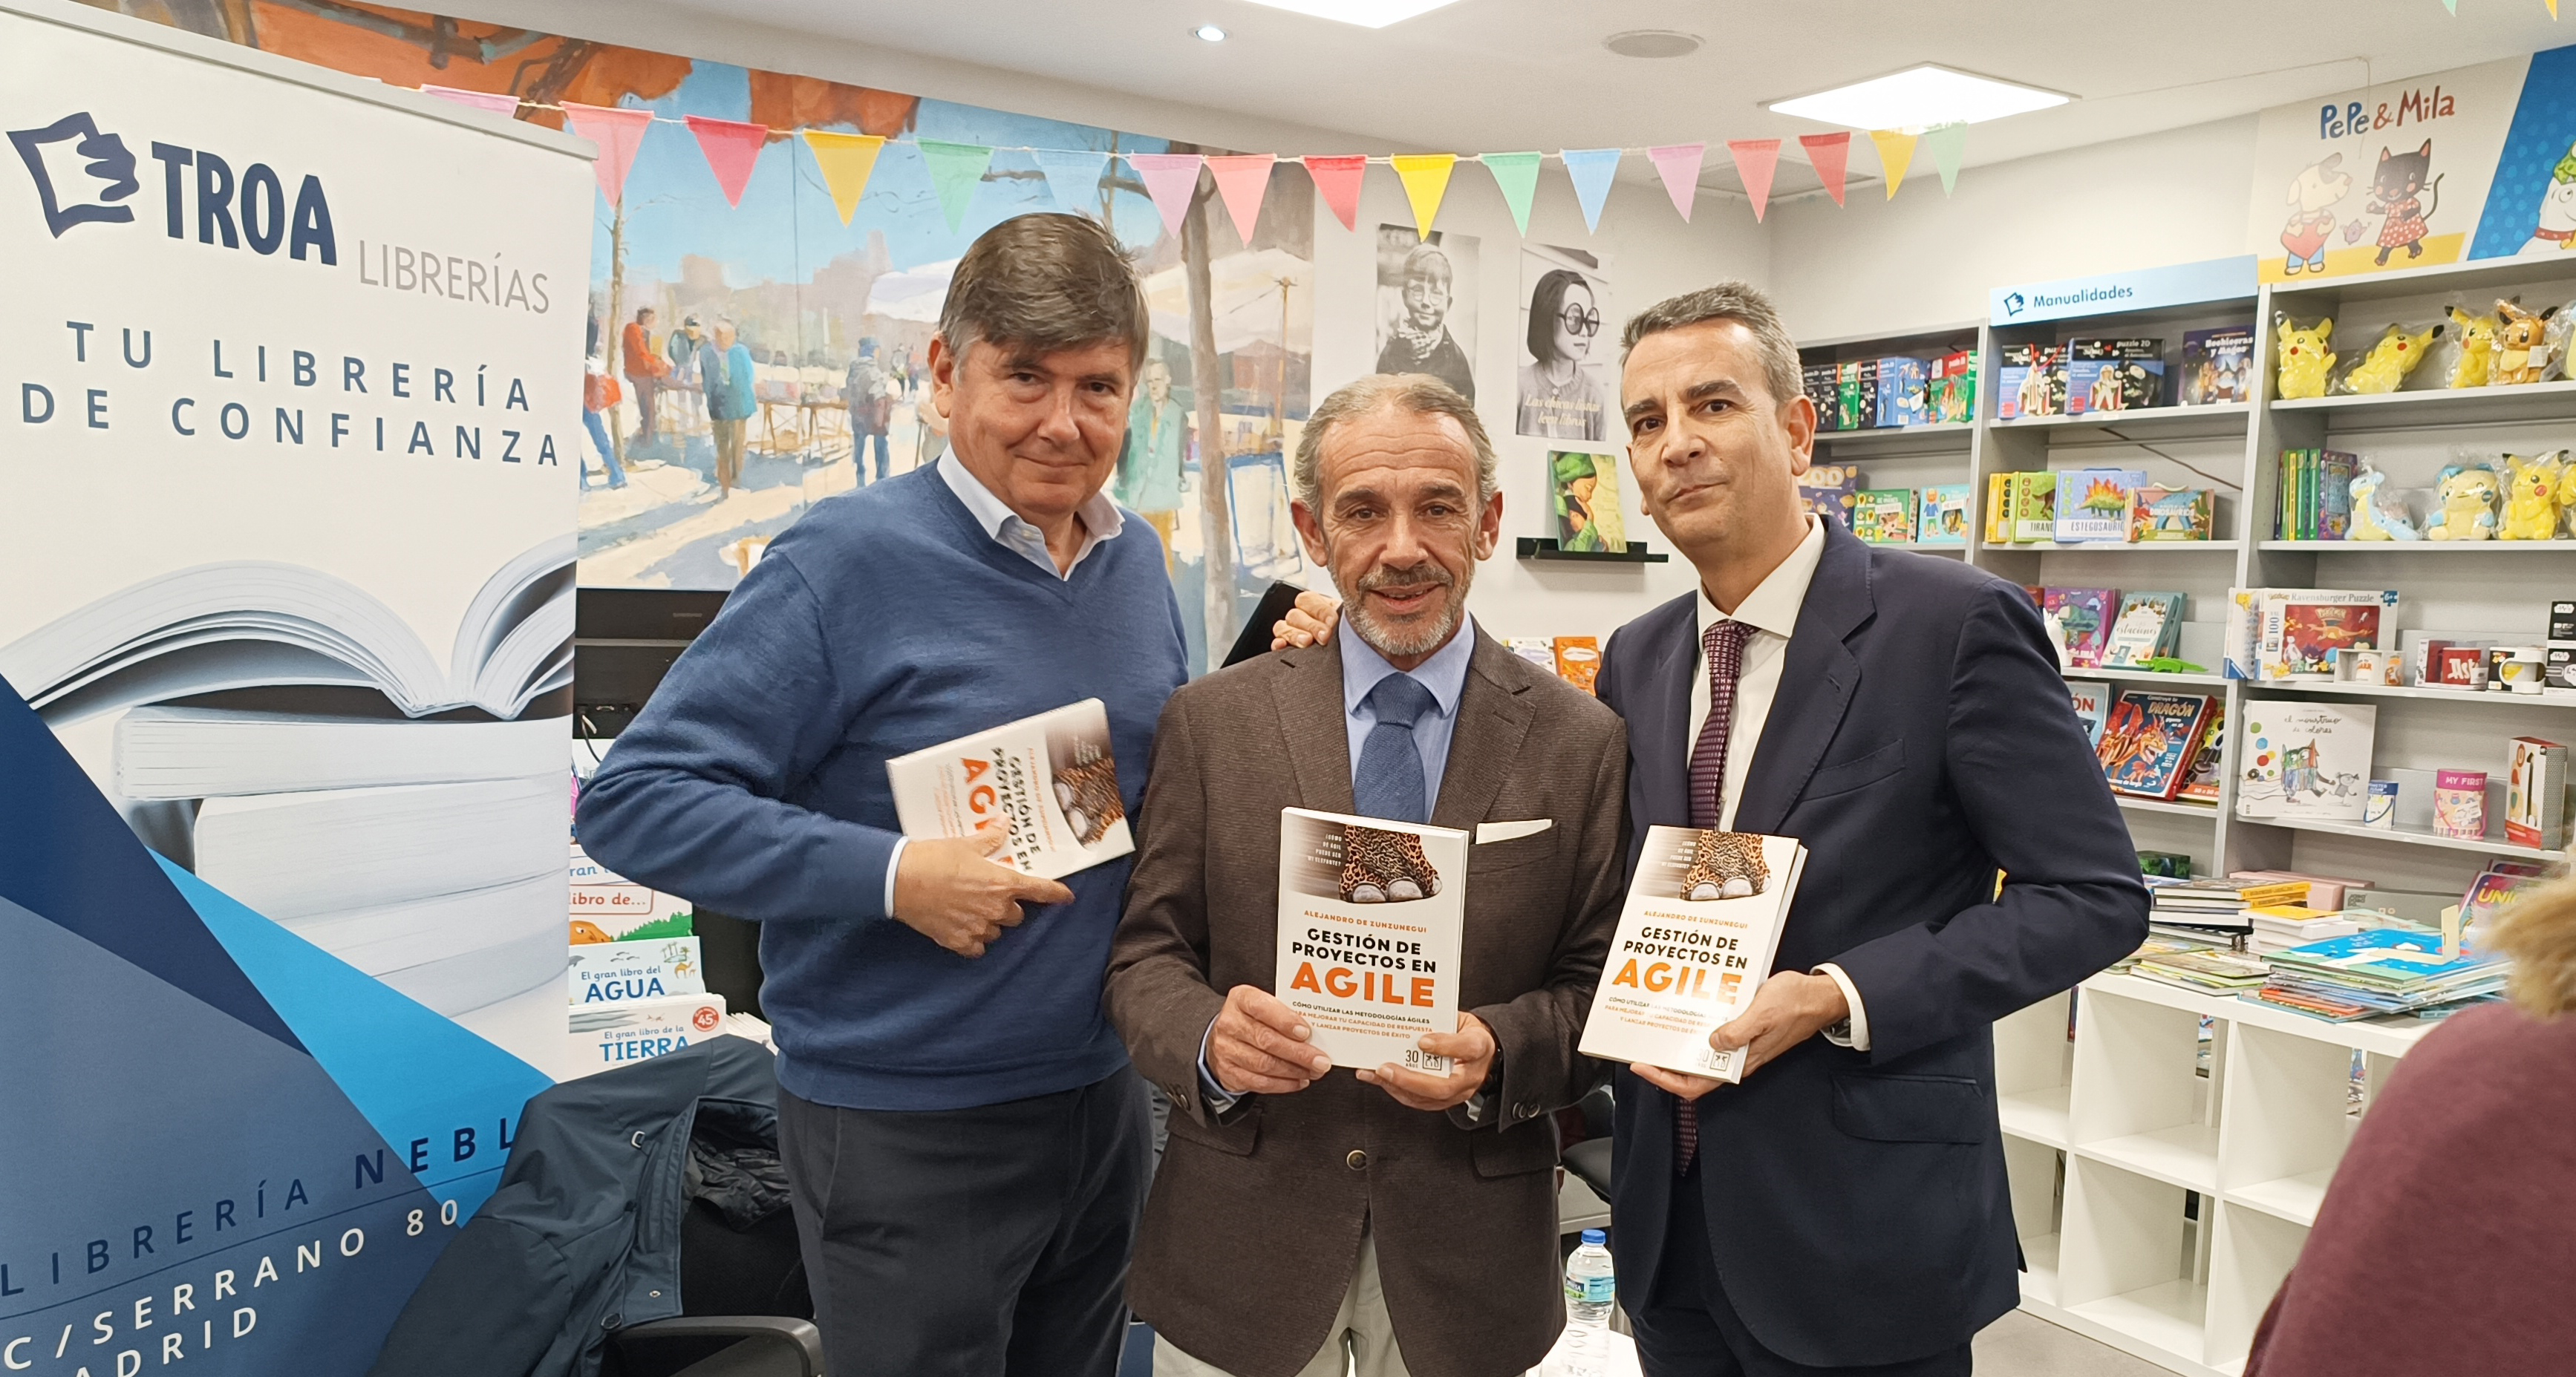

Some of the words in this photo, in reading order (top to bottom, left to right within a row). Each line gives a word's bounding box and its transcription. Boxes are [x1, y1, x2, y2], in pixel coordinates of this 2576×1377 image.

[2373, 102, 2394, 131] &
[2396, 85, 2456, 127] Mila
[151, 140, 338, 266] TROA
[359, 240, 550, 315] LIBRERÍAS
[2033, 285, 2133, 309] Manualidades
[67, 321, 151, 369] TU
[213, 338, 530, 413] LIBRERÍA
[1525, 395, 1543, 407] Las
[22, 383, 110, 430] DE
[172, 398, 558, 467] CONFIANZA
[1559, 413, 1586, 428] libros
[2291, 593, 2347, 603] Ravensburger
[2348, 593, 2375, 603] Puzzle
[2116, 624, 2157, 635] estaciones
[2269, 617, 2280, 634] 100
[2148, 701, 2195, 717] DRAGÓN
[2445, 776, 2459, 785] MY
[2461, 777, 2484, 786] FIRST
[1025, 832, 1042, 854] DE
[1304, 910, 1354, 923] ALEJANDRO
[1370, 920, 1426, 933] ZUNZUNEGUI
[1643, 911, 1686, 920] ALEJANDRO
[1308, 928, 1390, 952] GESTIÓN
[1397, 941, 1421, 955] DE
[1641, 927, 1712, 946] GESTIÓN
[1716, 936, 1738, 950] DE
[1292, 941, 1406, 969] PROYECTOS
[1412, 959, 1436, 973] EN
[1623, 941, 1721, 964] PROYECTOS
[1726, 955, 1747, 969] EN
[581, 971, 590, 980] El
[594, 971, 617, 981] gran
[621, 968, 642, 977] libro
[646, 966, 661, 975] del
[1290, 961, 1435, 1007] AGILE
[1611, 958, 1742, 1005] AGILE
[584, 978, 665, 1003] AGUA
[697, 1013, 714, 1025] 45
[1292, 1001, 1312, 1010] CÓMO
[1313, 1005, 1340, 1014] UTILIZAR
[1354, 1011, 1406, 1021] METODOLOGÍAS
[1407, 1015, 1430, 1024] ÁGILES
[1308, 1013, 1337, 1021] MEJORAR
[1349, 1019, 1386, 1028] CAPACIDAD
[1397, 1024, 1432, 1033] RESPUESTA
[616, 1030, 636, 1040] gran
[1317, 1023, 1341, 1031] LANZAR
[1343, 1027, 1380, 1036] PROYECTOS
[599, 1036, 689, 1062] TIERRA
[1406, 1050, 1419, 1063] 30
[405, 1200, 458, 1236] 80
[0, 1179, 309, 1296] LIBRERÍA
